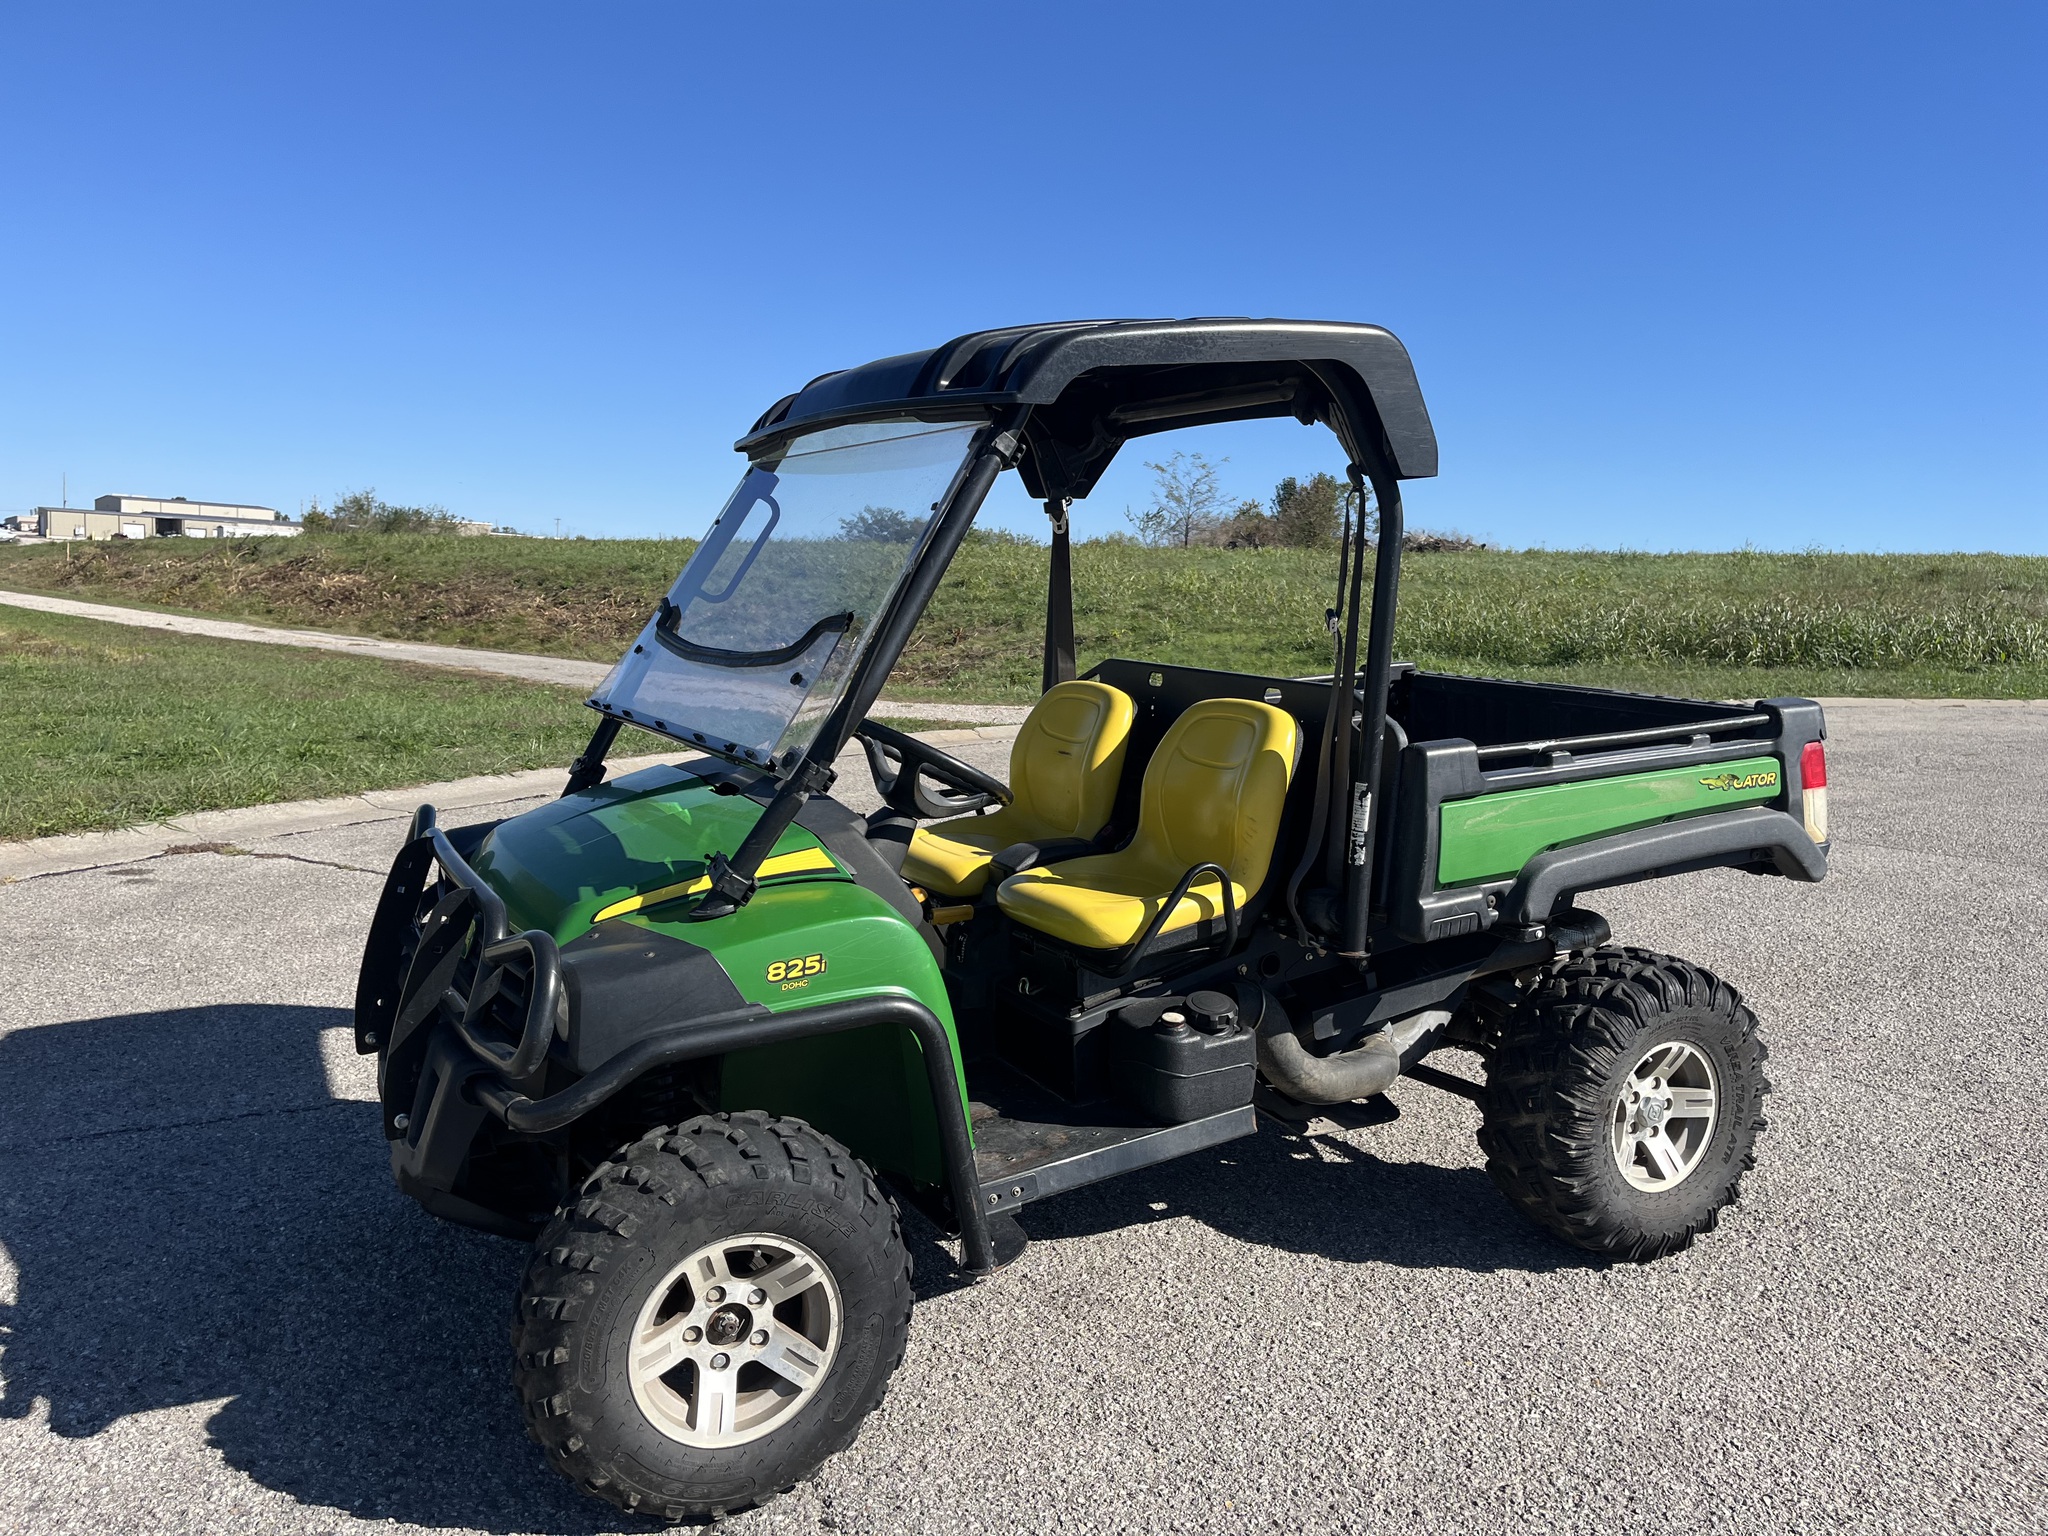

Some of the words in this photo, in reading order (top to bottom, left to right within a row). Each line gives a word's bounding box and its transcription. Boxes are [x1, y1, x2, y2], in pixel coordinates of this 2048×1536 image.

[1733, 772, 1776, 789] GATOR
[767, 953, 827, 984] 825i
[781, 980, 809, 992] DOHC
[725, 1190, 858, 1239] CARLISLE
